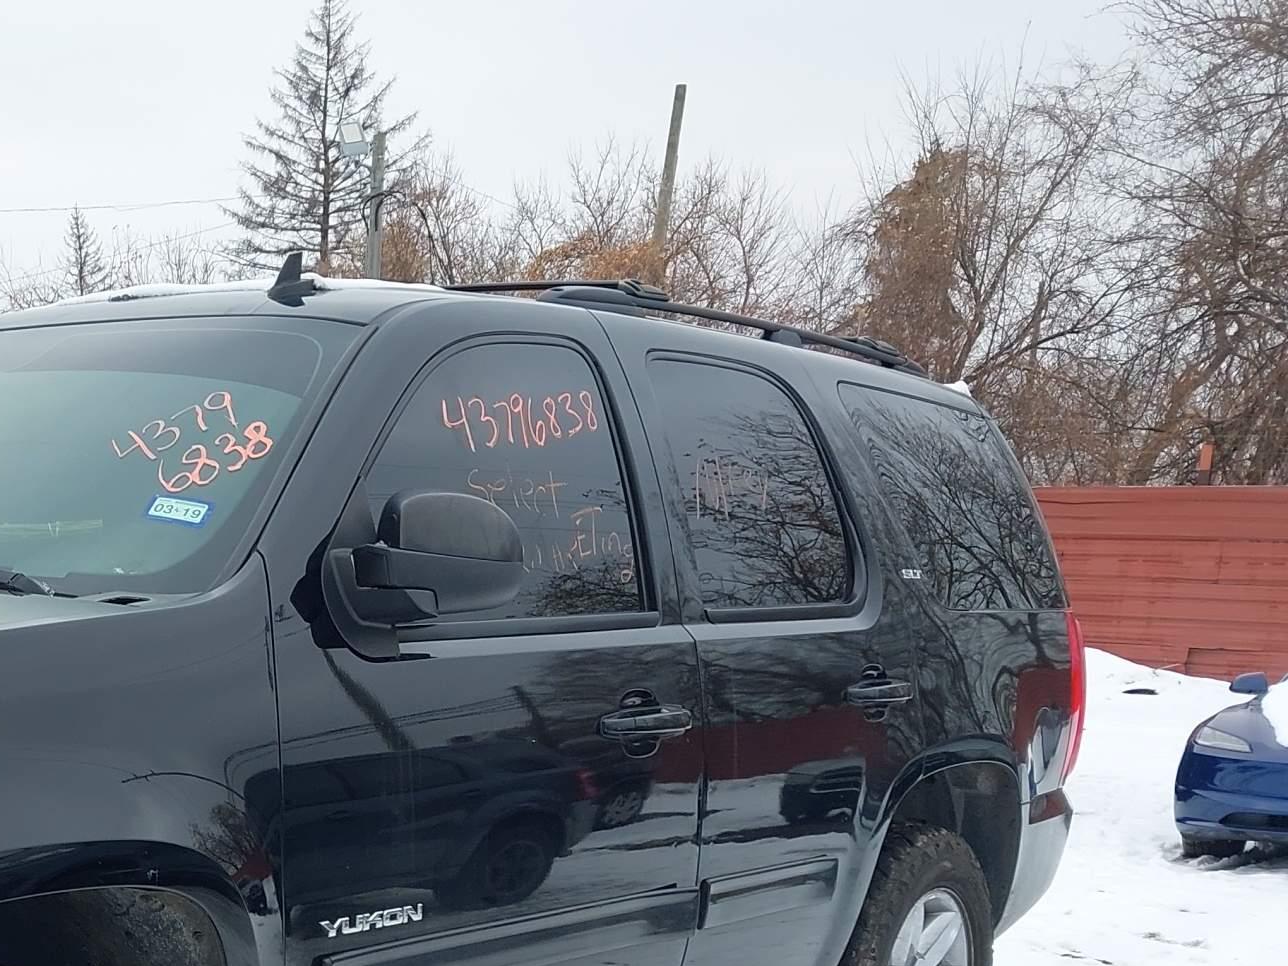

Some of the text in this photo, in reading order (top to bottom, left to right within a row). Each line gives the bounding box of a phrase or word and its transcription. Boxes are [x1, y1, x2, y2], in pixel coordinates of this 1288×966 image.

[111, 391, 238, 460] 4379
[442, 390, 598, 453] 43796838
[158, 421, 273, 492] 6838
[318, 903, 424, 938] YUKON
